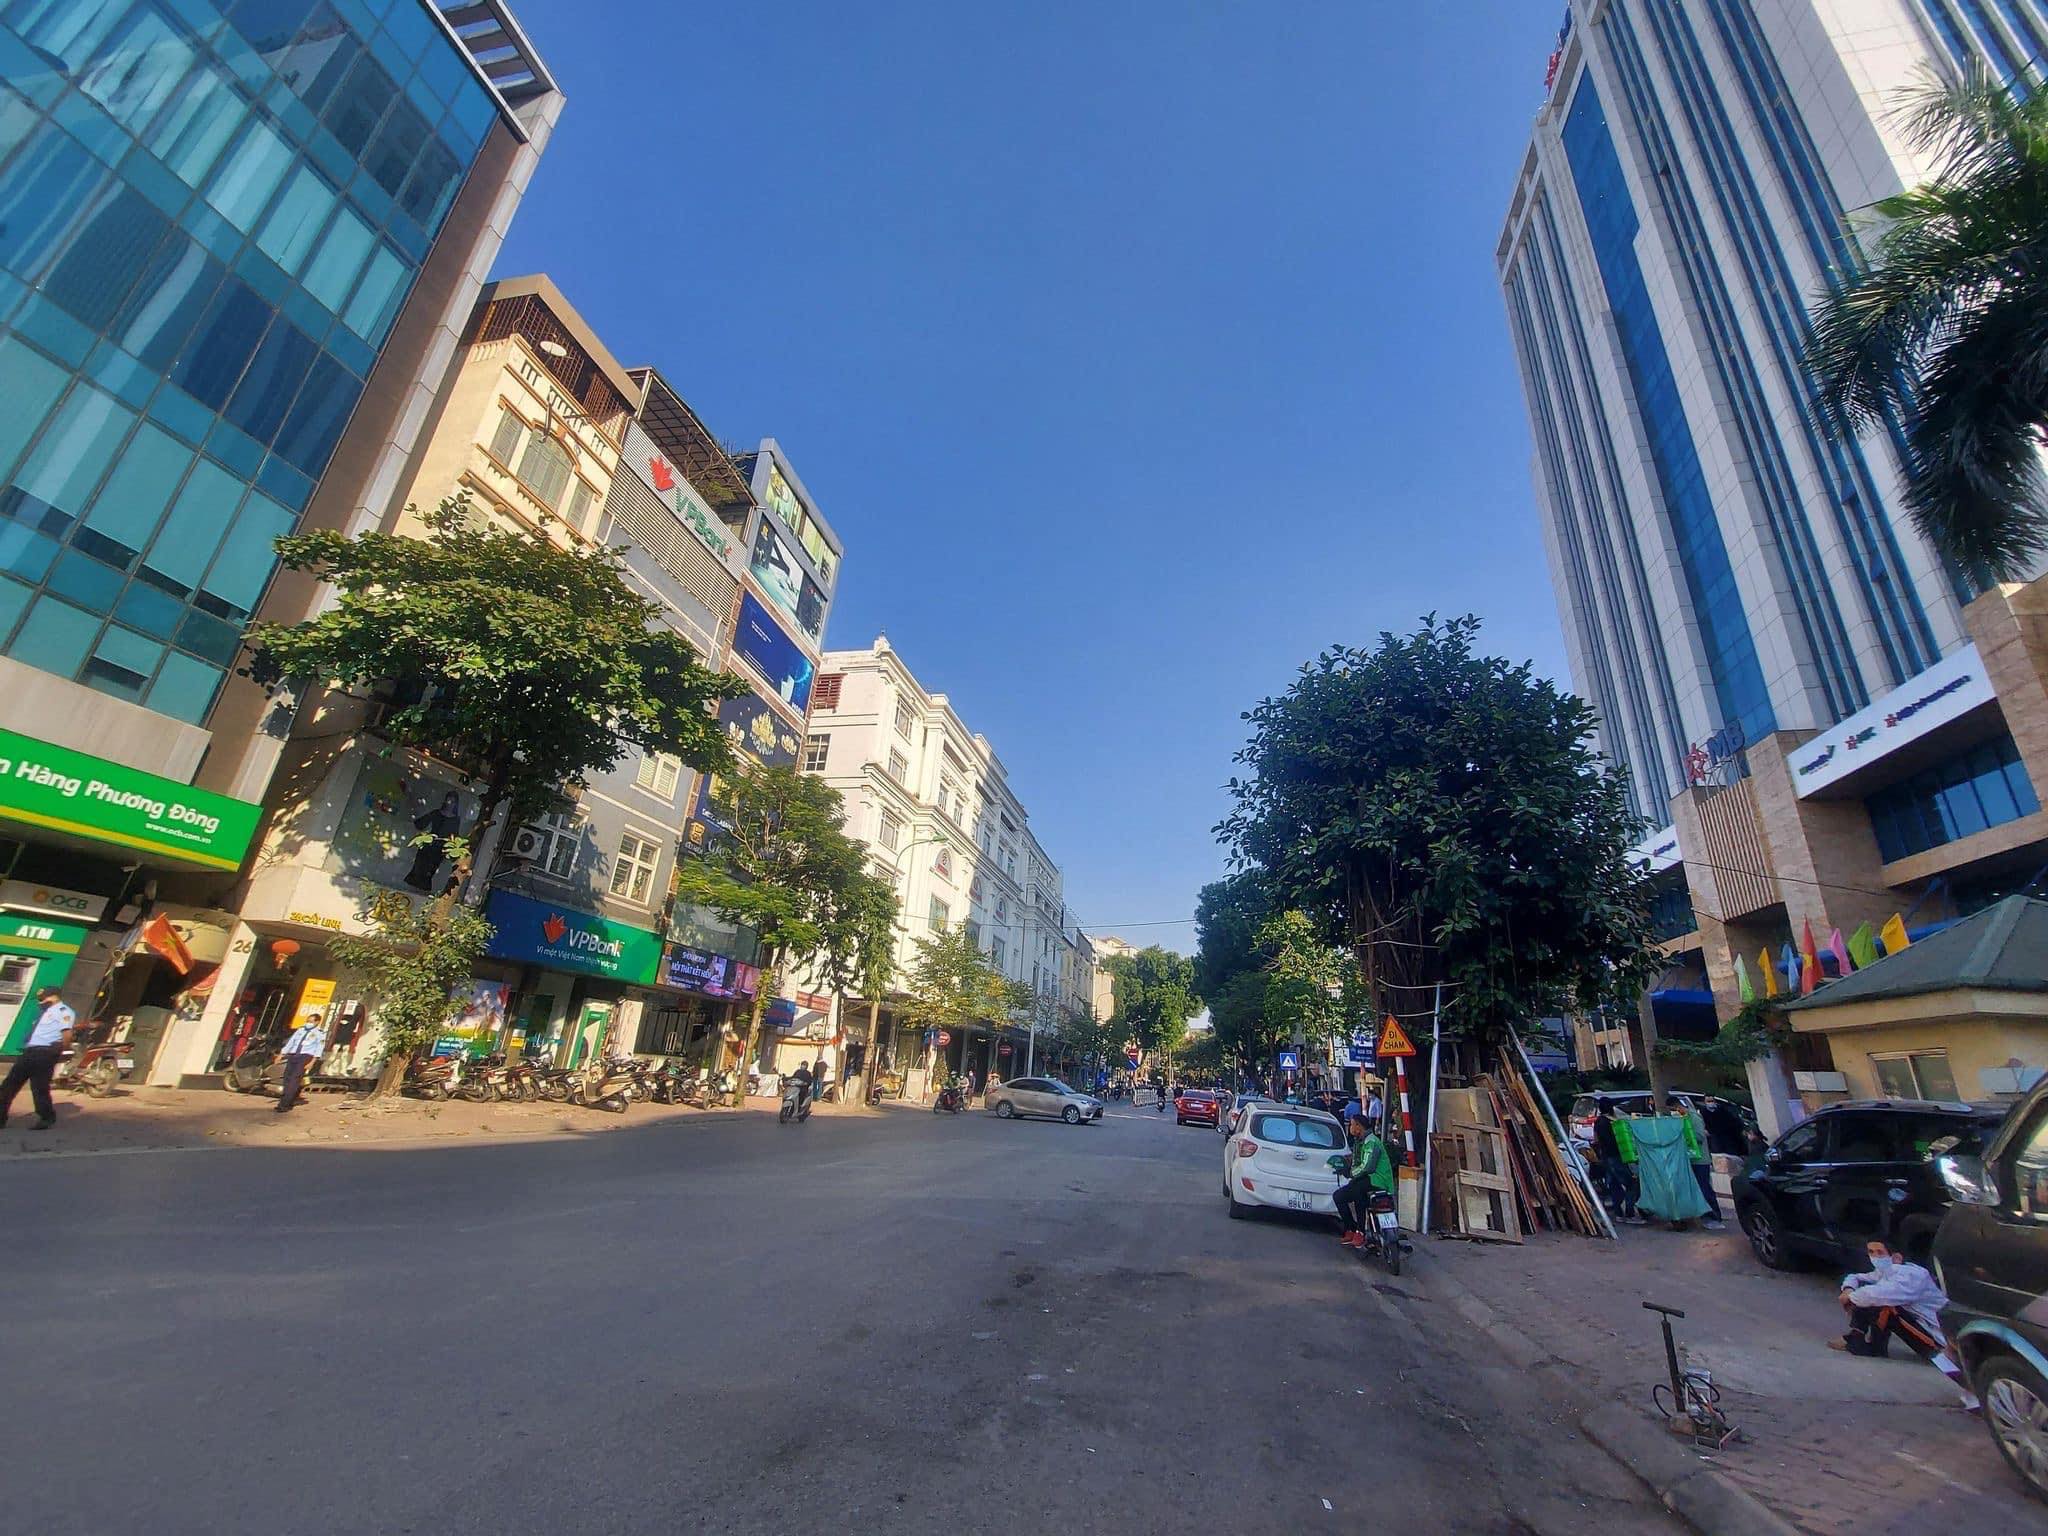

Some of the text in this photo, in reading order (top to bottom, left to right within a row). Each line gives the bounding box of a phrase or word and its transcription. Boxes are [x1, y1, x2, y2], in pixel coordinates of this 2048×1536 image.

[675, 486, 732, 563] VPBank
[1706, 718, 1745, 764] MB
[15, 761, 81, 797] Hàng
[84, 780, 166, 819] Phương
[168, 803, 220, 834] Đông
[50, 894, 89, 909] OCB
[16, 925, 55, 940] ATM
[568, 928, 625, 958] VPBank
[232, 940, 251, 954] 26
[1388, 1030, 1398, 1039] ĐI
